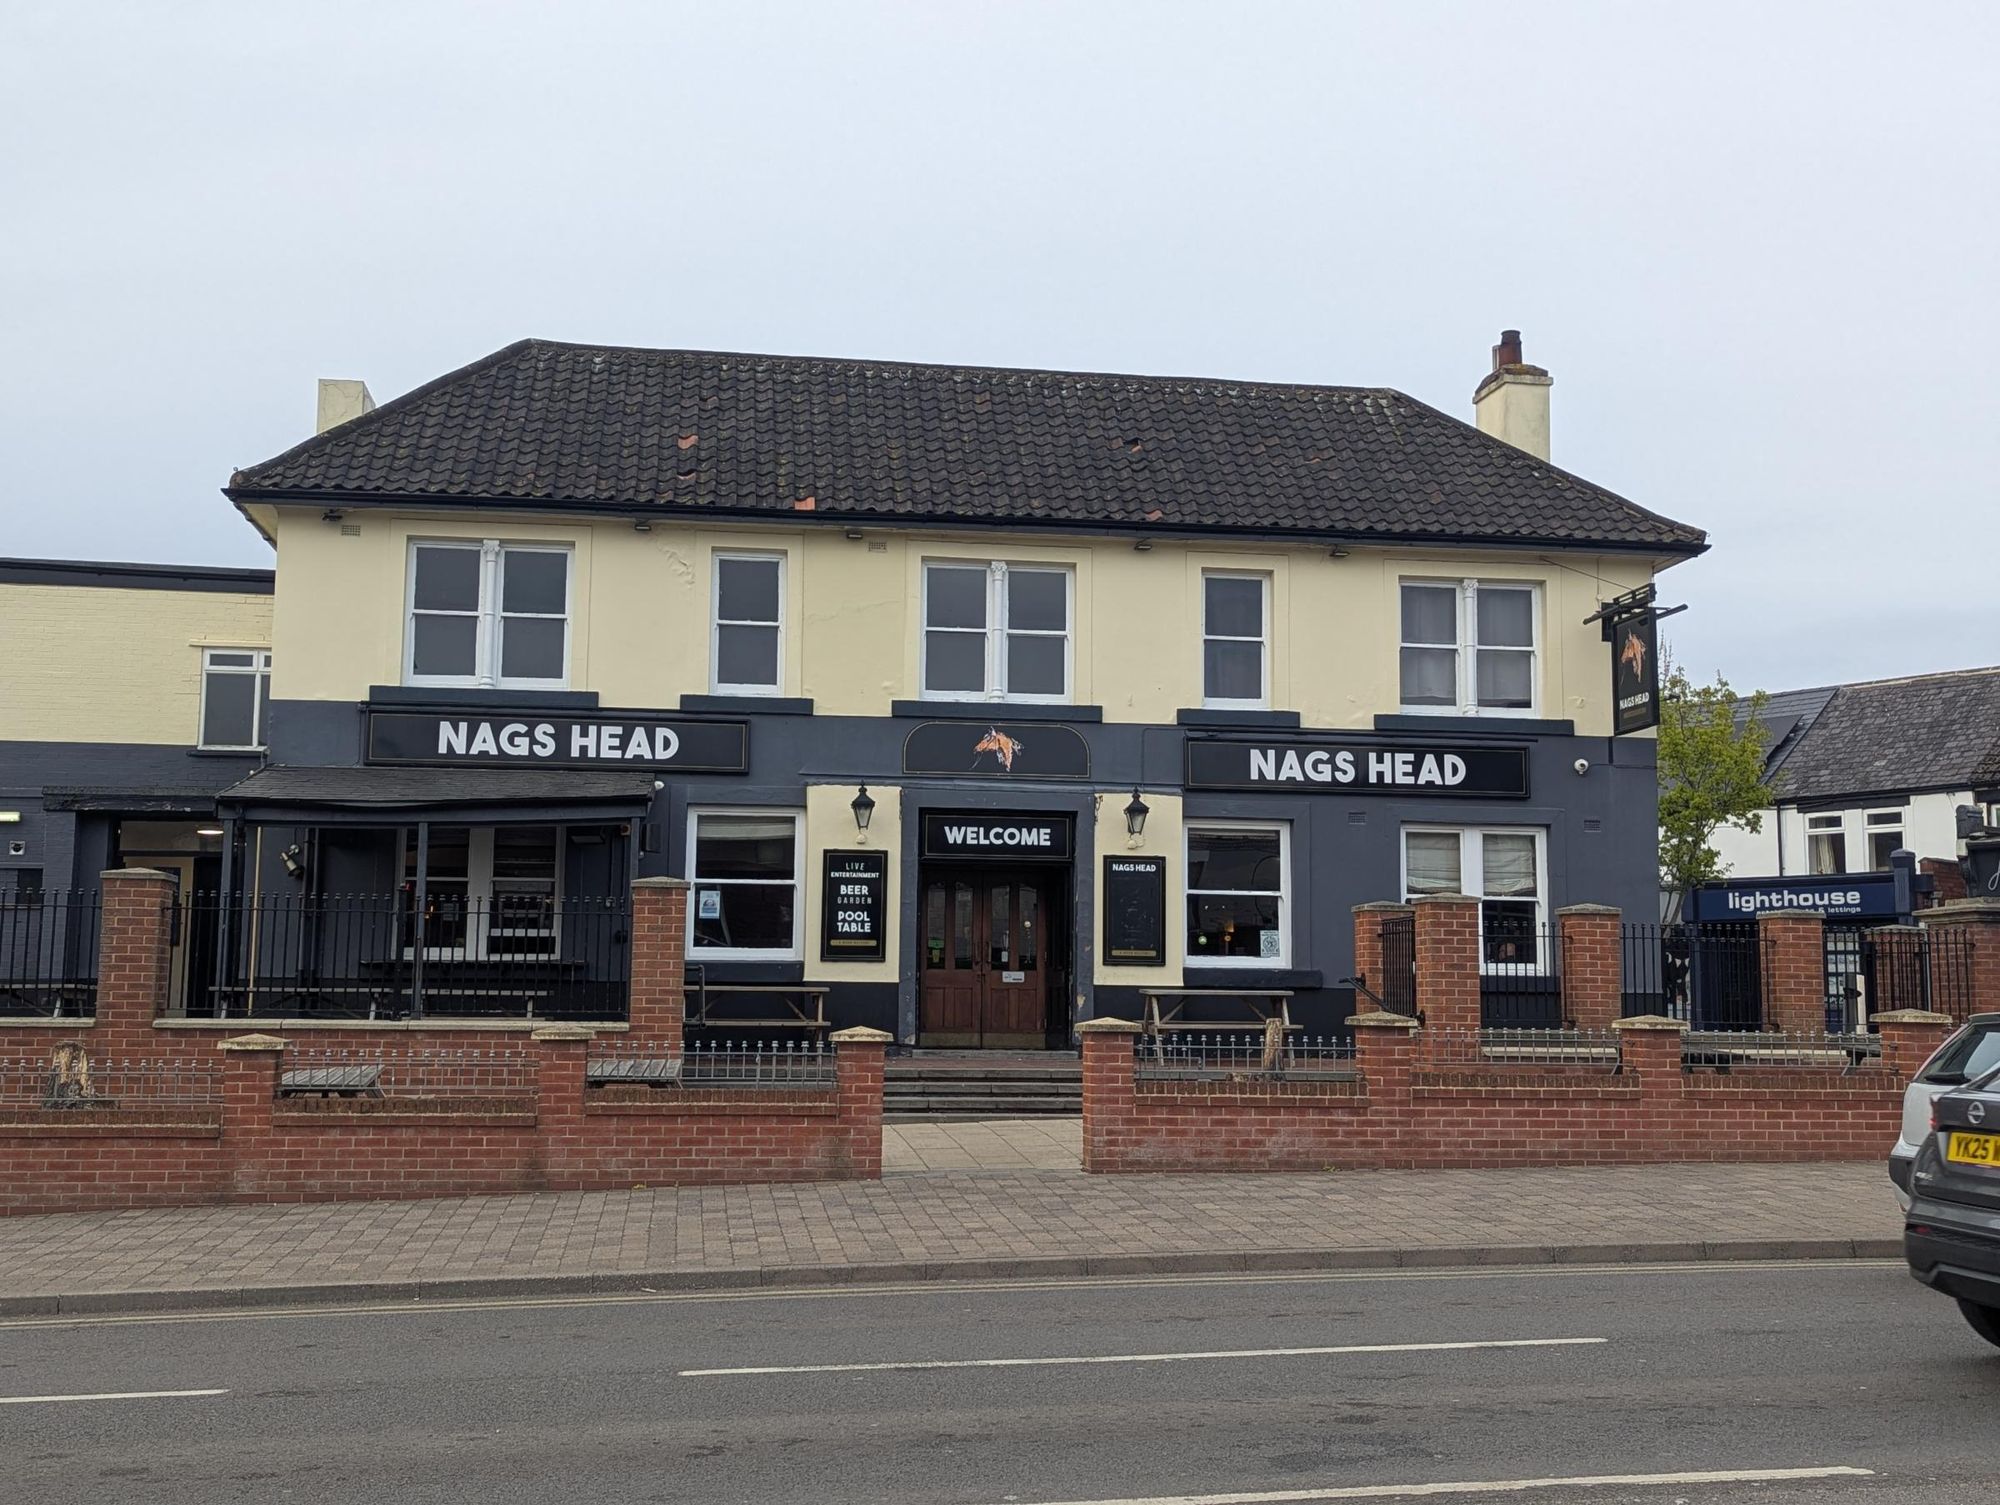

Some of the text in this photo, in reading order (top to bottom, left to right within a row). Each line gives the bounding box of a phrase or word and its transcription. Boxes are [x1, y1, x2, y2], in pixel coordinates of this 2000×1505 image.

[1620, 692, 1650, 710] NAGS HEAD
[438, 721, 679, 760] NAGS HEAD
[1250, 749, 1466, 786] NAGS HEAD
[944, 826, 1051, 846] WELCOME
[845, 862, 865, 870] LIVE
[1112, 863, 1156, 872] NAGS HEAD
[840, 885, 869, 895] BEER
[1728, 890, 1861, 912] lighthouse
[838, 911, 870, 921] POOL
[1828, 906, 1862, 914] lettings
[836, 922, 871, 932] TABLE
[1955, 1136, 1991, 1160] YK25
